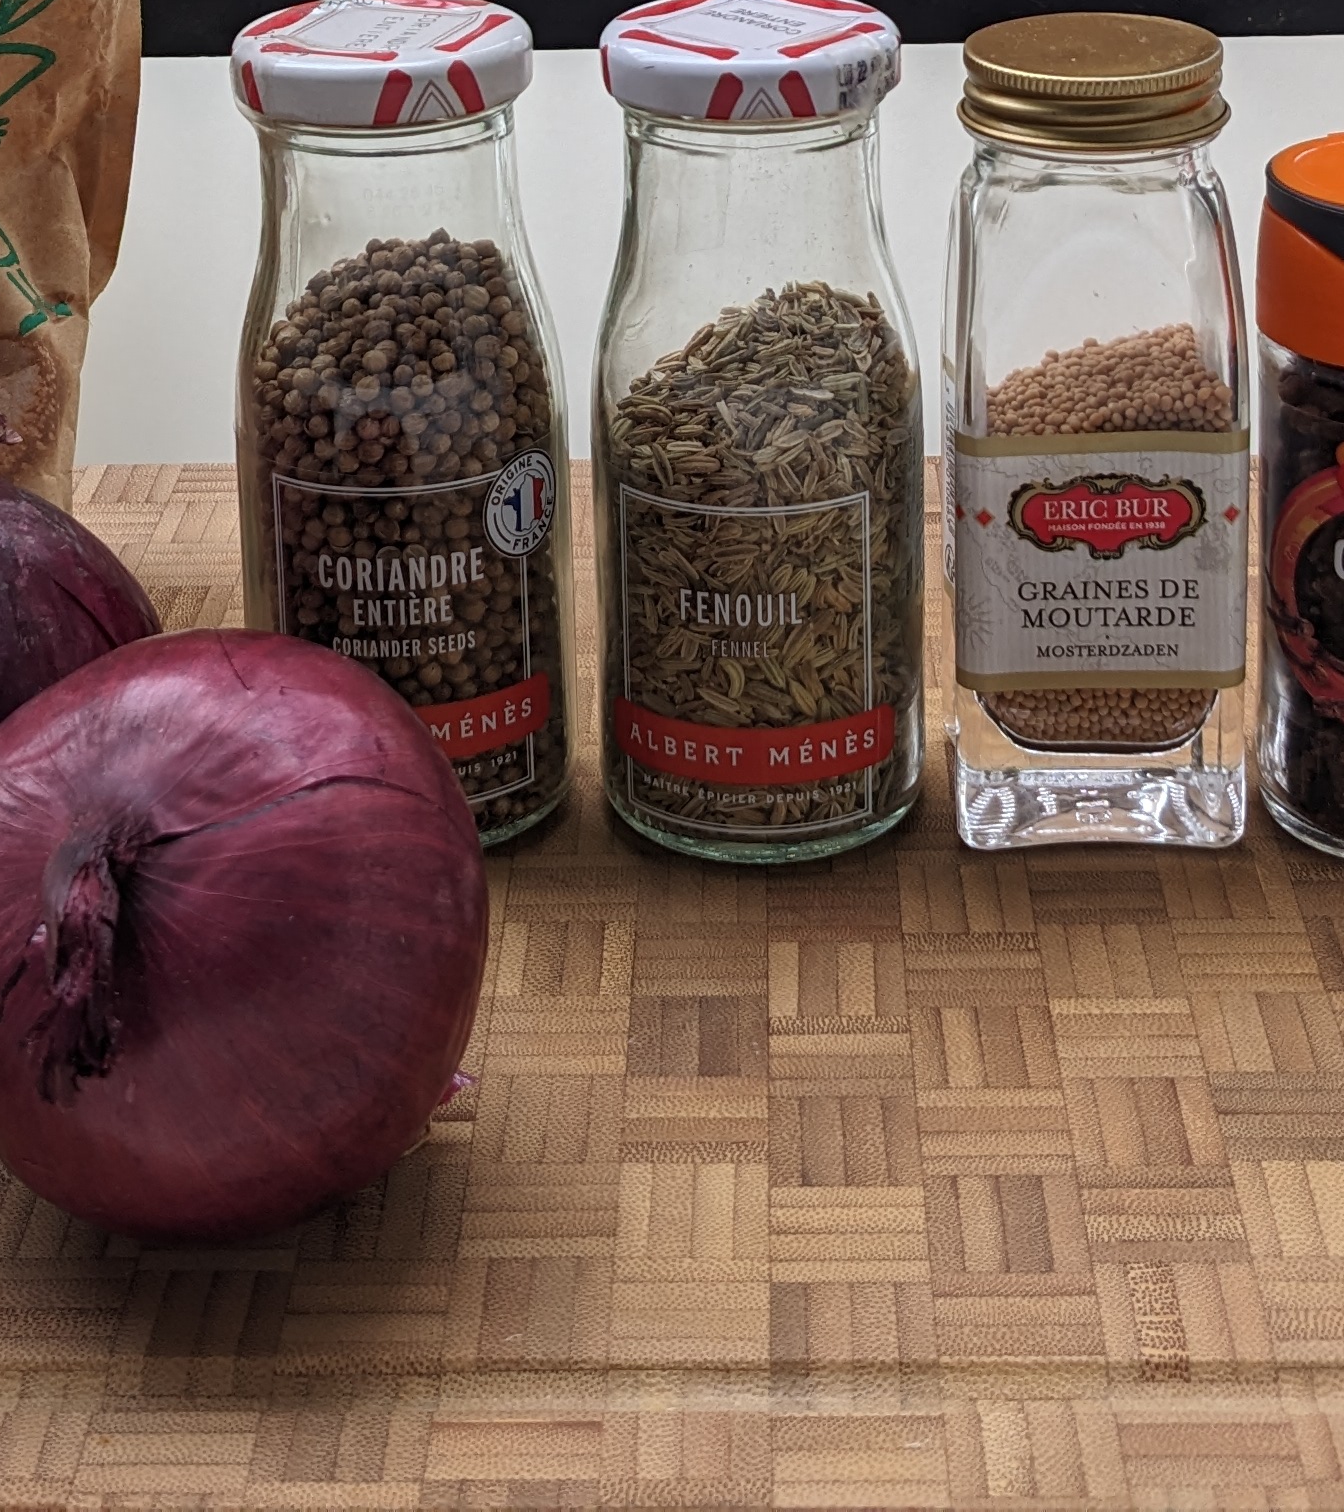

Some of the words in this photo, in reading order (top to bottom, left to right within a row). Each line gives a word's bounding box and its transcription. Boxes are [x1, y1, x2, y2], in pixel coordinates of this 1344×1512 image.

[491, 454, 534, 506] ORIGINE
[1043, 499, 1108, 520] ERIC
[1115, 497, 1172, 518] BUR
[512, 495, 554, 551] FRANCE
[1048, 522, 1086, 532] MAISON
[1088, 520, 1127, 530] FONDÉE
[1129, 521, 1143, 530] EN
[317, 545, 485, 591] CORIANDRE
[1017, 580, 1150, 602] GRAINES
[1158, 579, 1201, 600] DE
[353, 589, 454, 627] ENTIÈRE
[679, 588, 804, 627] FENOUIL
[1021, 606, 1197, 629] MOUTARDE
[332, 636, 421, 658] CORIANDER
[427, 630, 477, 655] SEEDS
[710, 639, 771, 658] FENNEL
[1036, 643, 1179, 658] MOSTERDZADEN
[429, 696, 532, 741] MÉNÈS
[629, 721, 744, 767] ALBERT
[769, 727, 876, 767] MÉNÈS
[450, 764, 482, 777] UIS
[490, 750, 517, 768] 1921
[766, 789, 821, 804] DEPUIS
[828, 780, 858, 796] 1921
